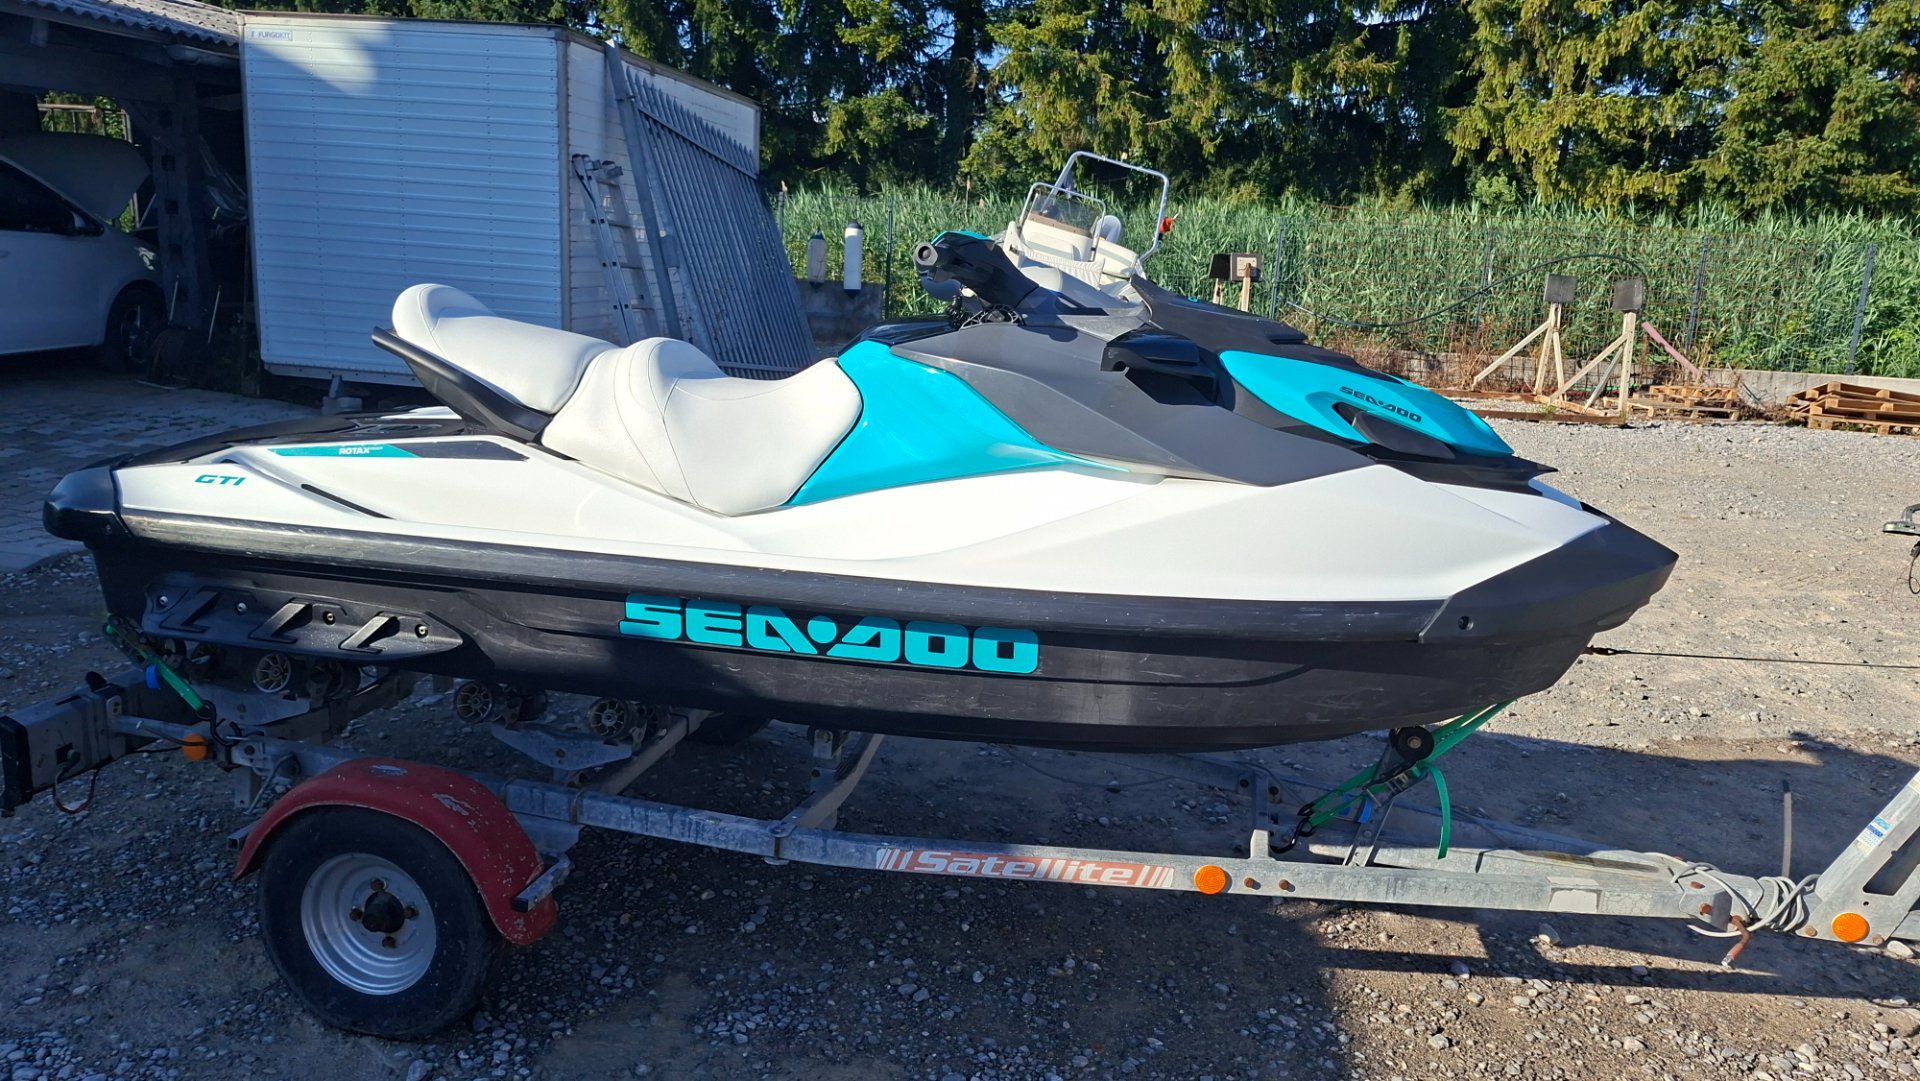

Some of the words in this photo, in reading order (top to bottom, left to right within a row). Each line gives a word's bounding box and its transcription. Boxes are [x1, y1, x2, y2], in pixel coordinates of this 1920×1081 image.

[338, 447, 370, 455] ROTAX
[195, 474, 247, 486] GTI
[914, 850, 1133, 885] Satellite
